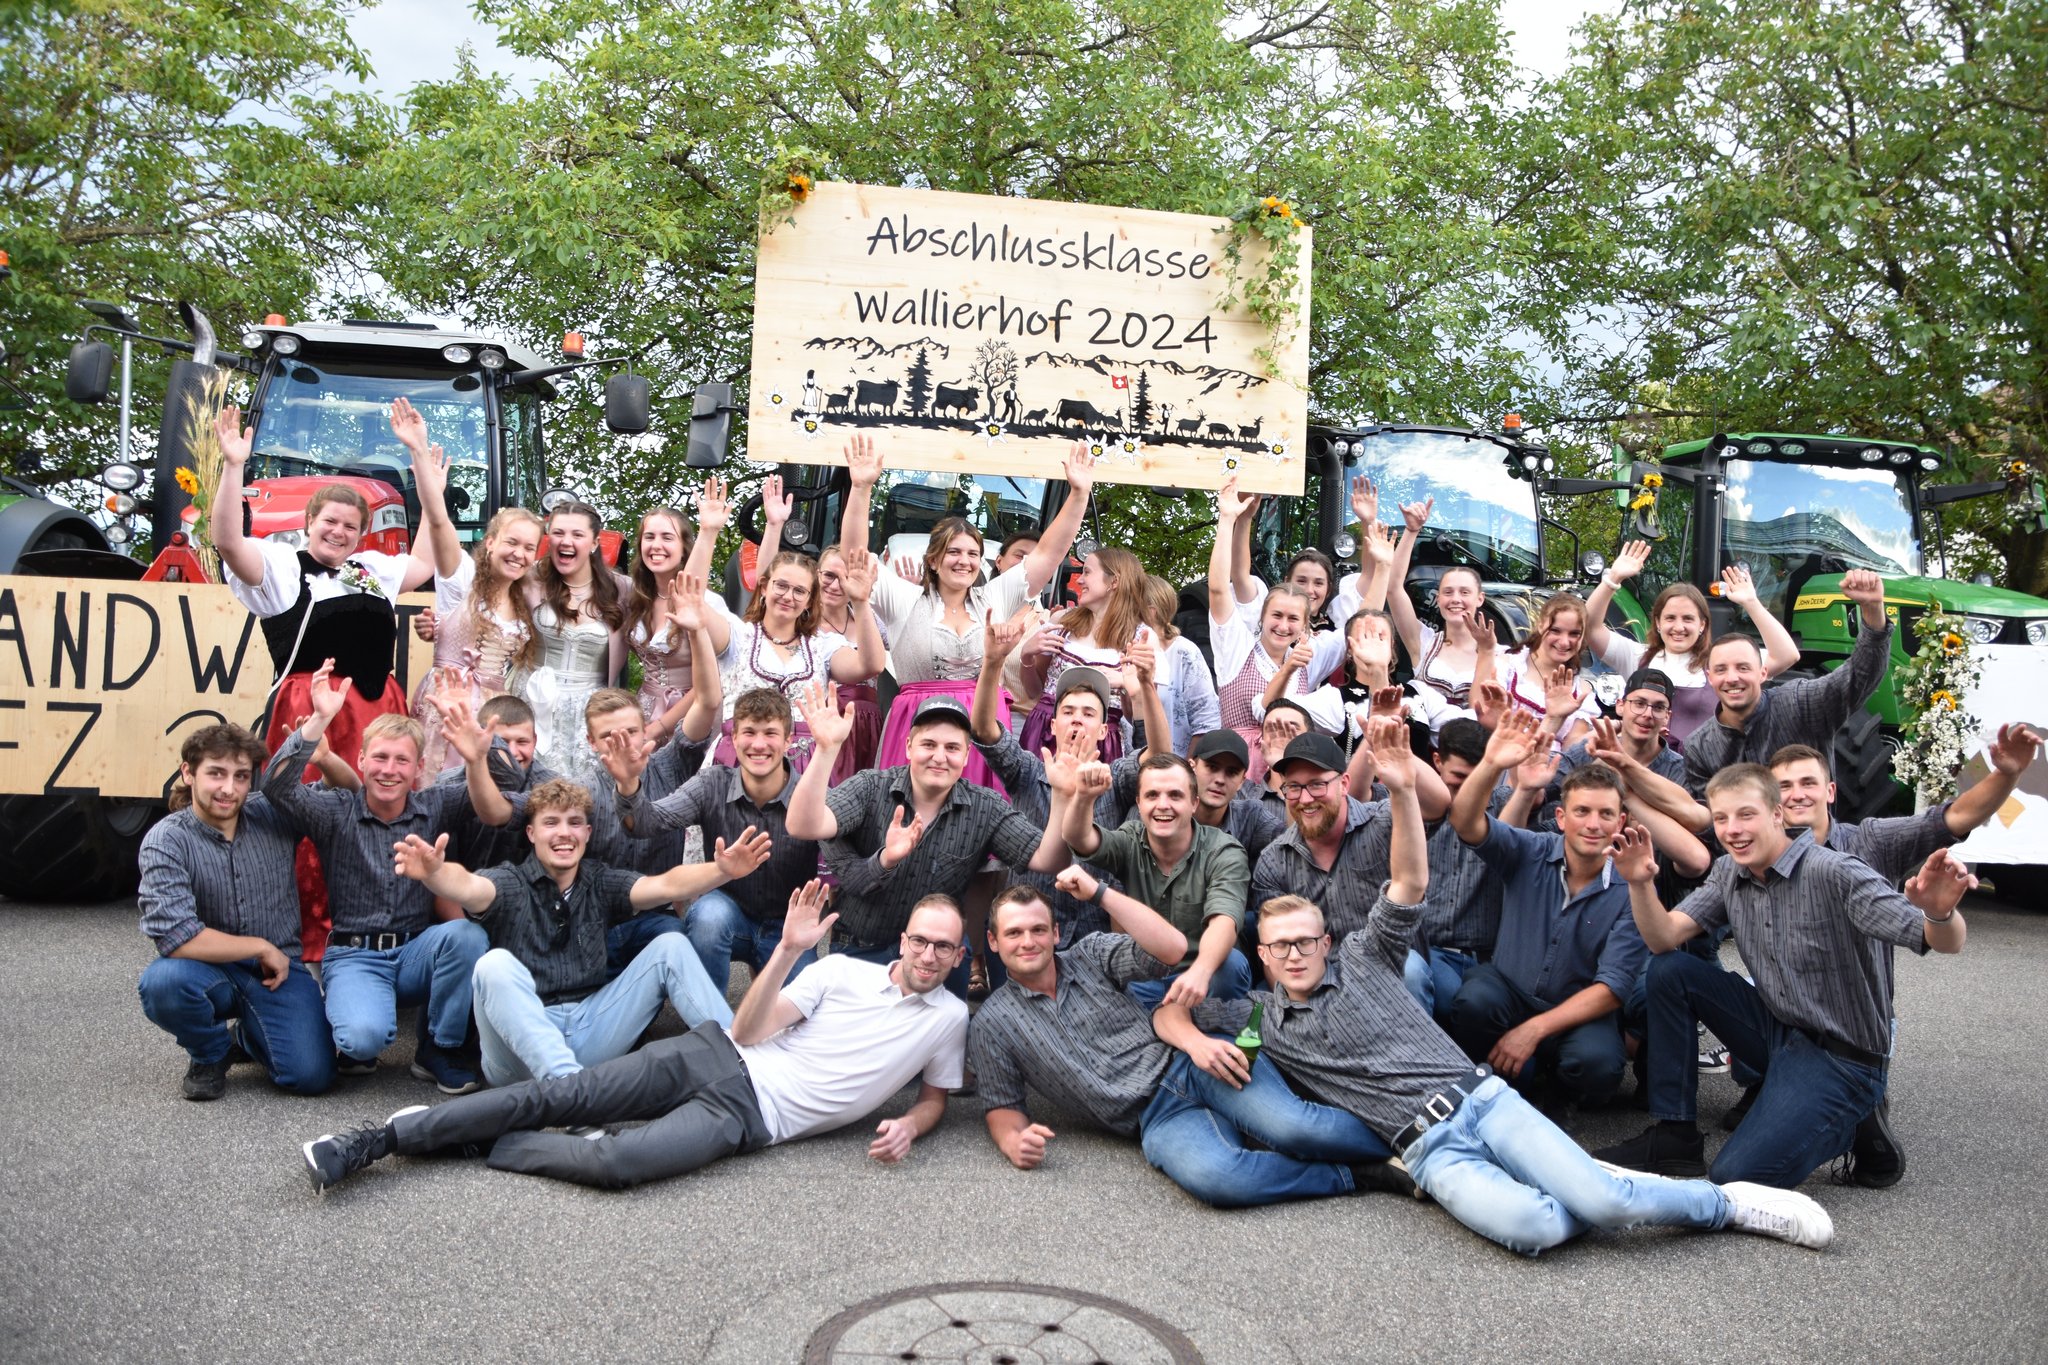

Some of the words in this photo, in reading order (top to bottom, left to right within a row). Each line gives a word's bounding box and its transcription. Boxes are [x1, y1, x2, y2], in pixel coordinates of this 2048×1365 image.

[867, 214, 1212, 280] Abschlussklasse
[854, 288, 1073, 343] Wallierhof
[1088, 307, 1218, 354] 2024
